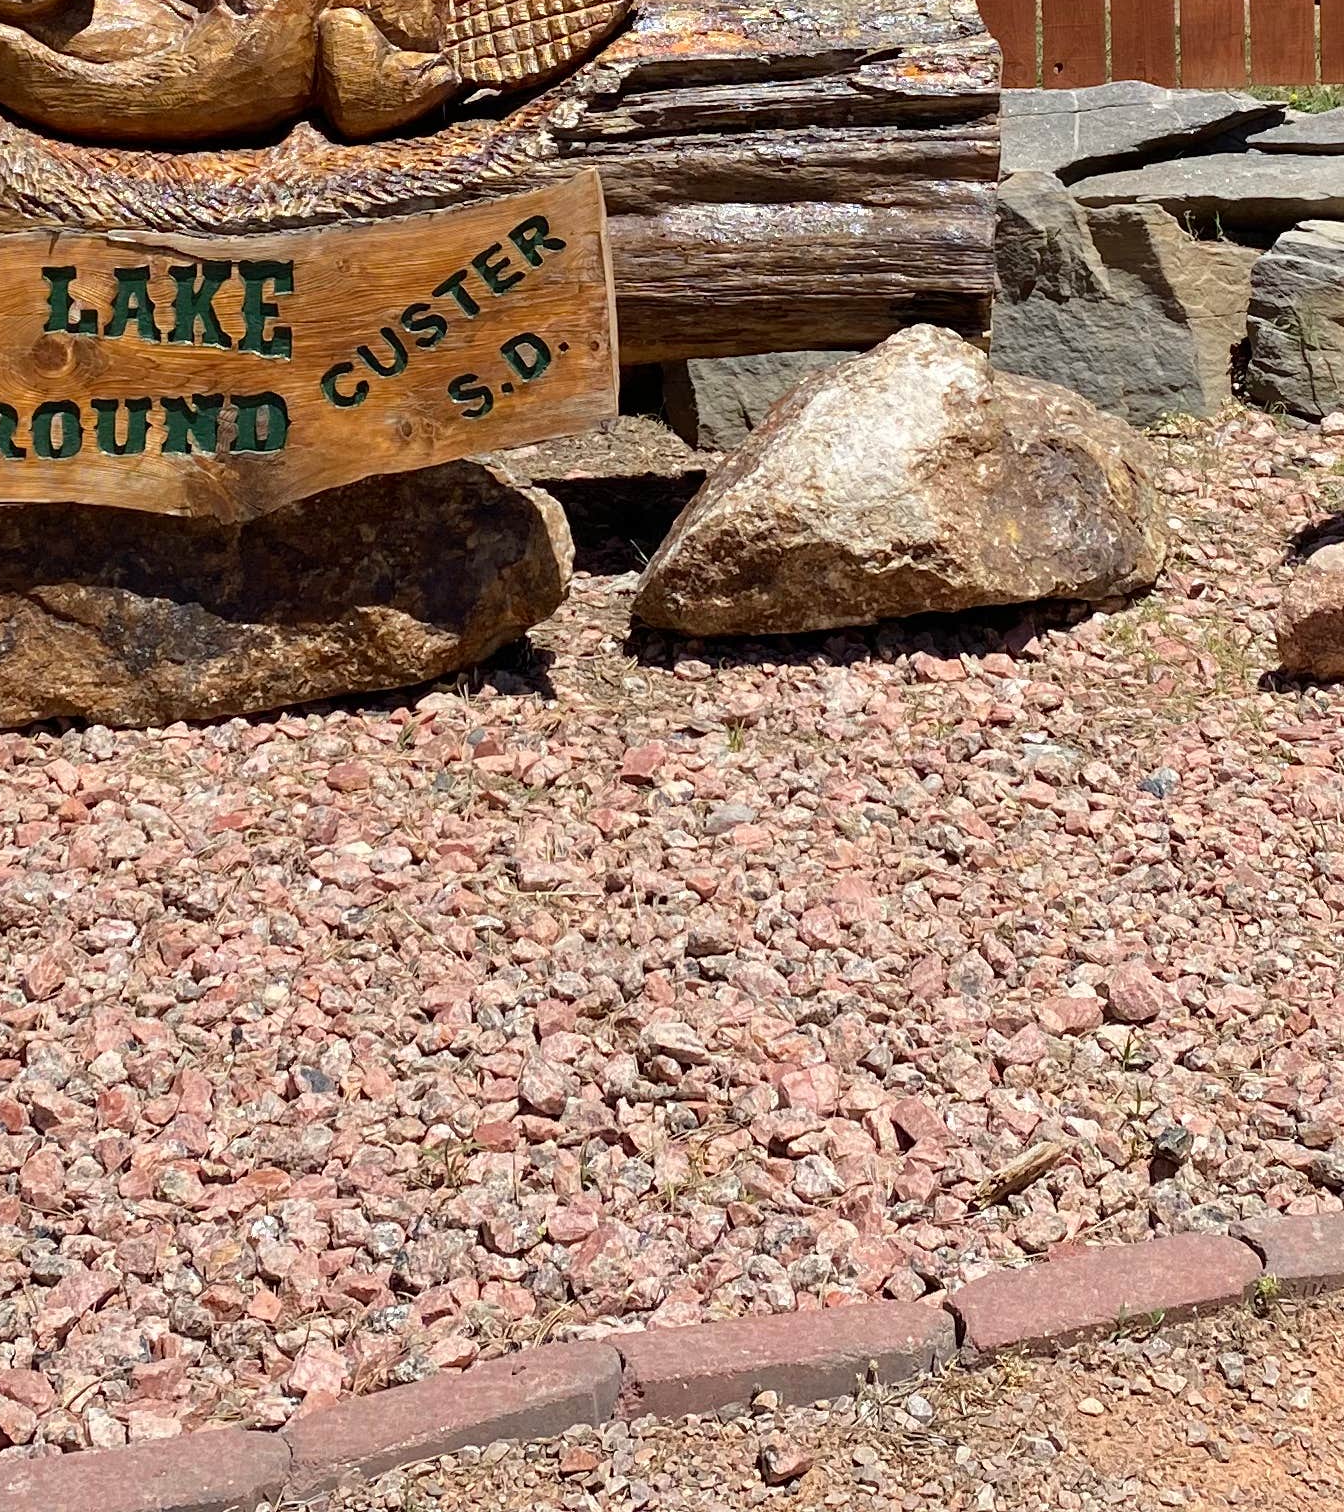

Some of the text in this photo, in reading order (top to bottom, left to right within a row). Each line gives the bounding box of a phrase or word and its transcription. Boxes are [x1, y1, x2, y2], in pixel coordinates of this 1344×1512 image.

[40, 260, 295, 362] LAKE
[320, 215, 567, 409] CUSTER
[447, 332, 570, 419] S.D.
